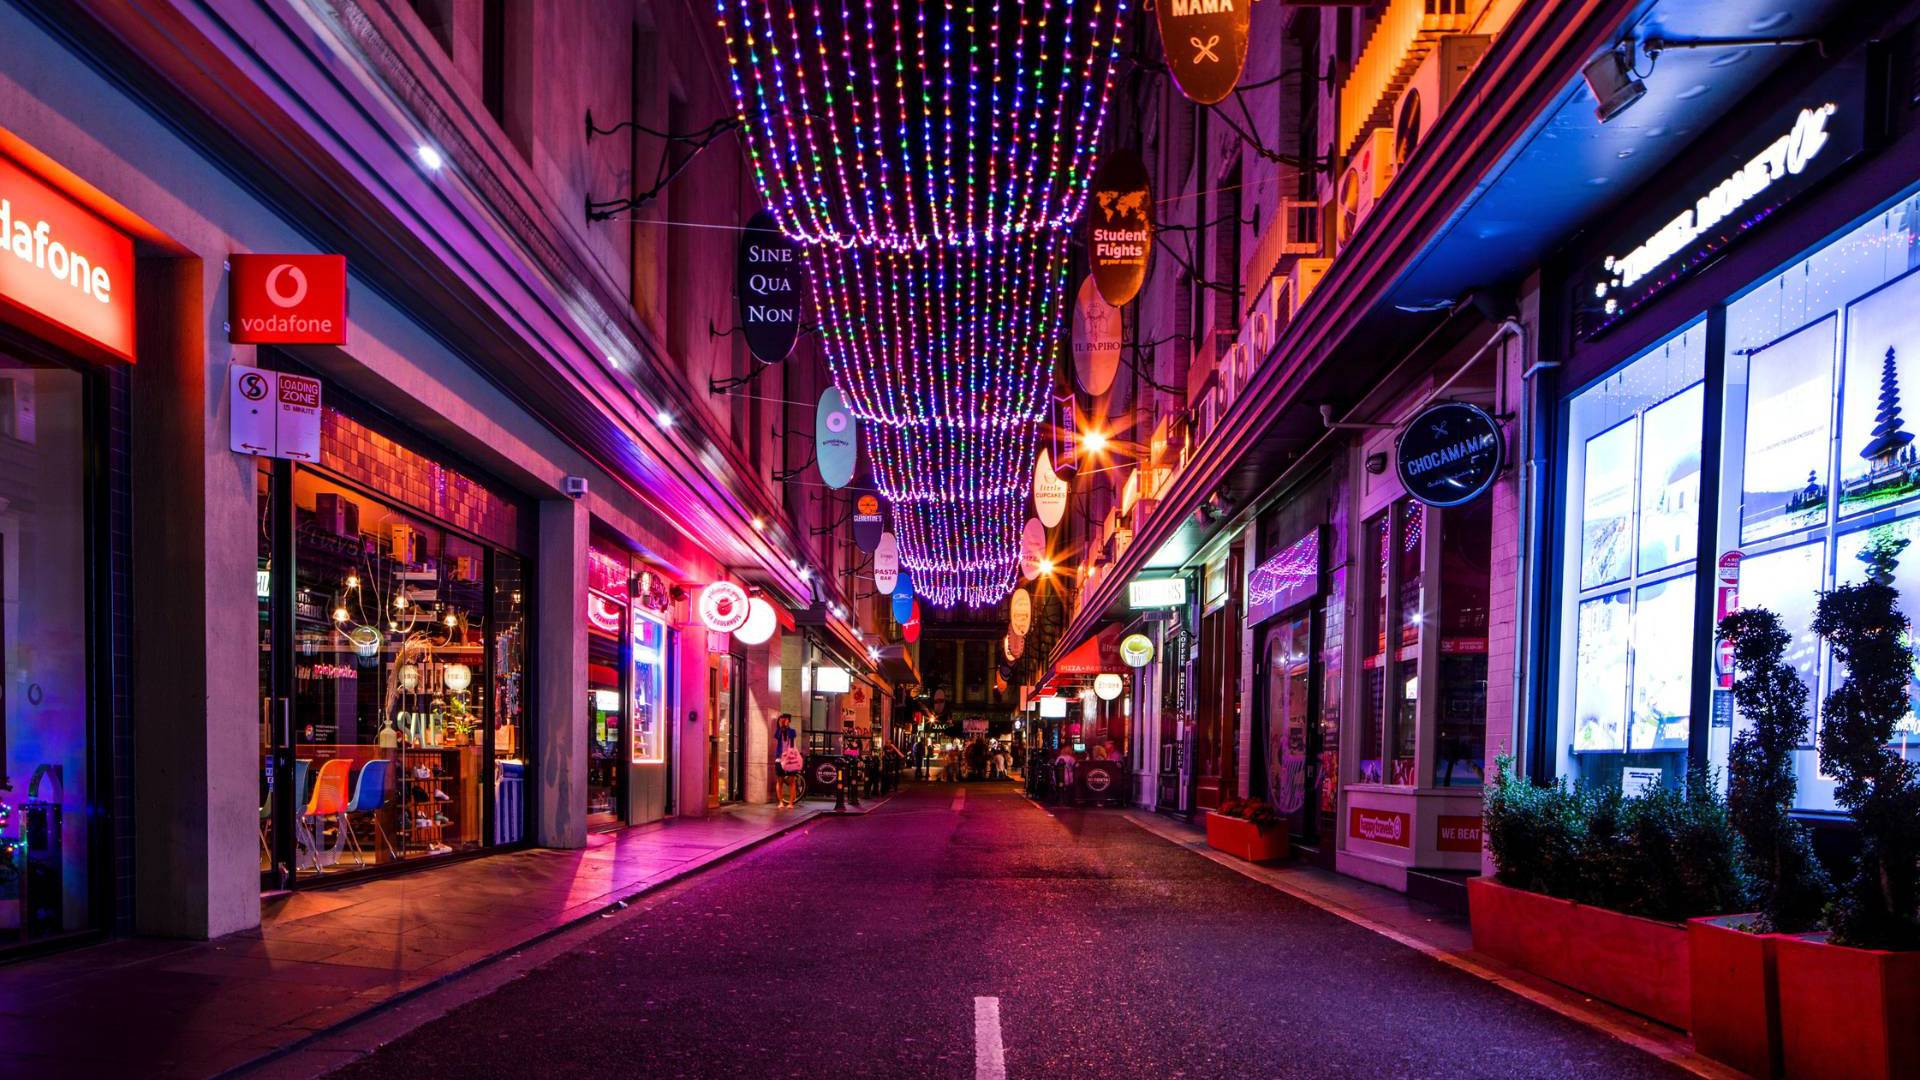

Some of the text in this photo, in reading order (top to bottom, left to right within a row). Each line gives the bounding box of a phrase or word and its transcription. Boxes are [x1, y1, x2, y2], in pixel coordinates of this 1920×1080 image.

[1094, 229, 1147, 242] Student
[1097, 243, 1143, 259] Flights
[241, 315, 332, 333] vodafone
[1075, 341, 1121, 352] IL PAPIRO
[280, 379, 319, 395] LOADING
[282, 390, 316, 405] ZONE
[1407, 433, 1494, 475] CHOCAMAMA
[1060, 664, 1081, 672] PIZZA
[397, 711, 443, 749] SALE
[1442, 828, 1480, 841] WE BEAT
